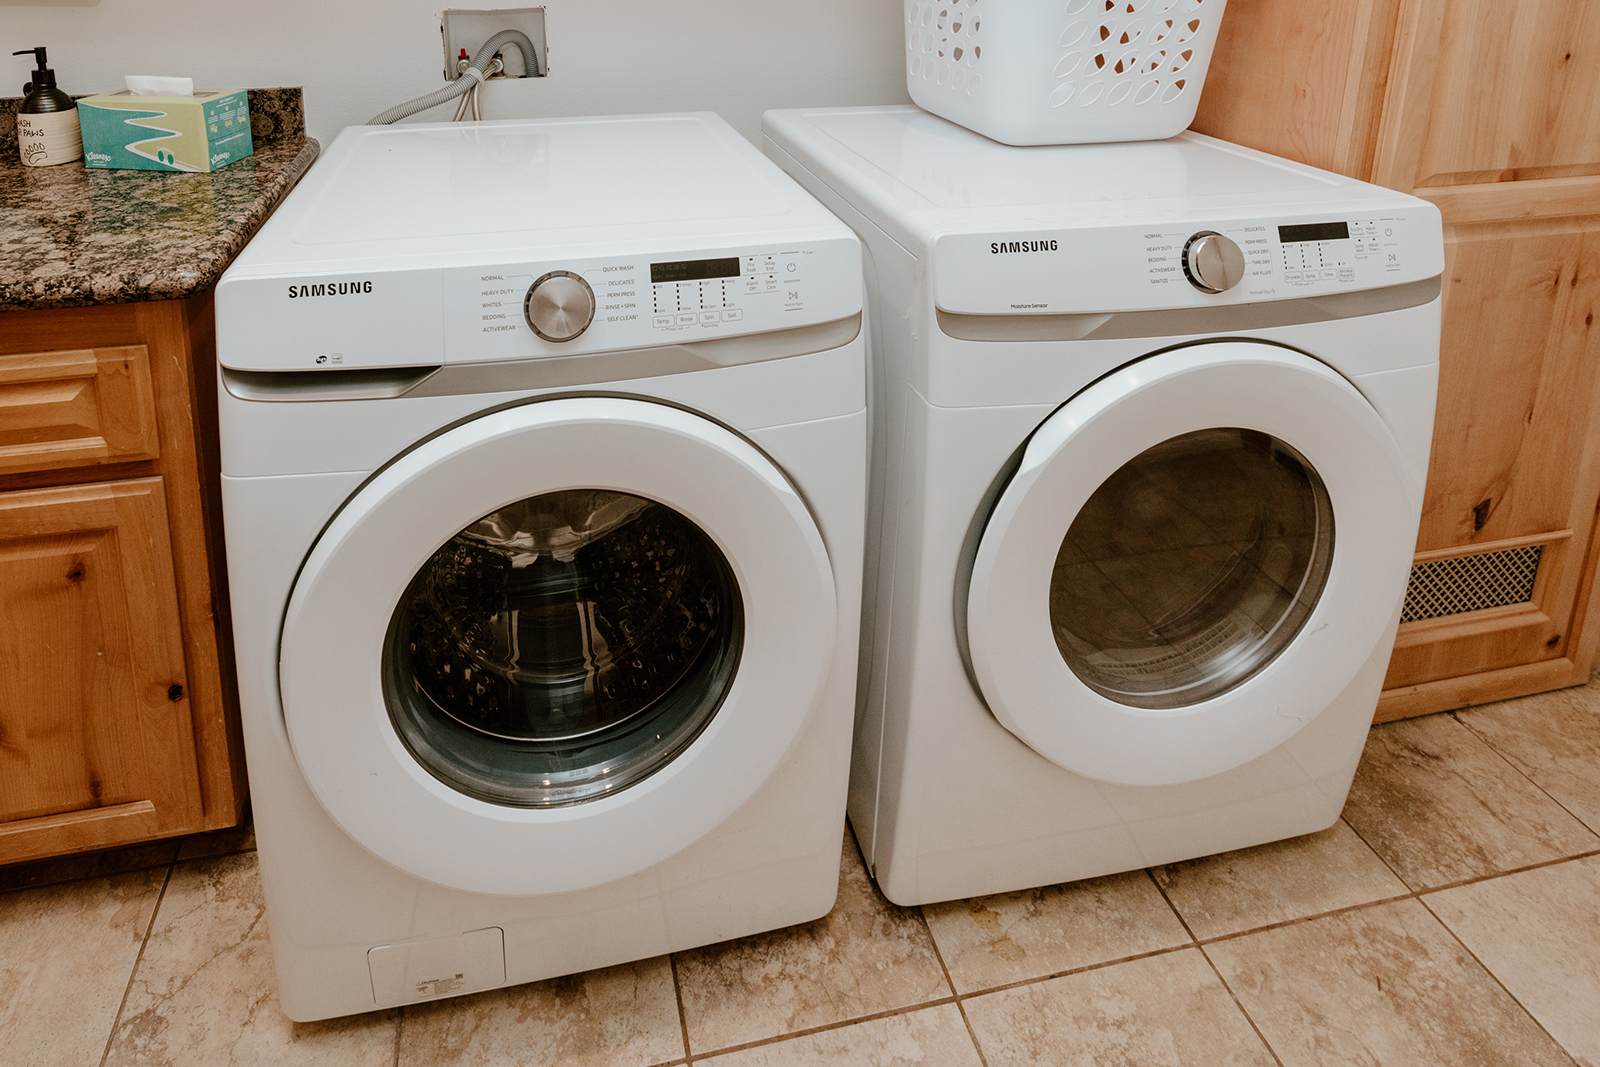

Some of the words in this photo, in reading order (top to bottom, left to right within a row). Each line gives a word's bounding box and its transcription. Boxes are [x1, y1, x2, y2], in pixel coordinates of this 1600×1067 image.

[23, 129, 44, 137] PAWS
[990, 240, 1058, 254] SAMSUNG
[288, 280, 372, 298] SAMSUNG
